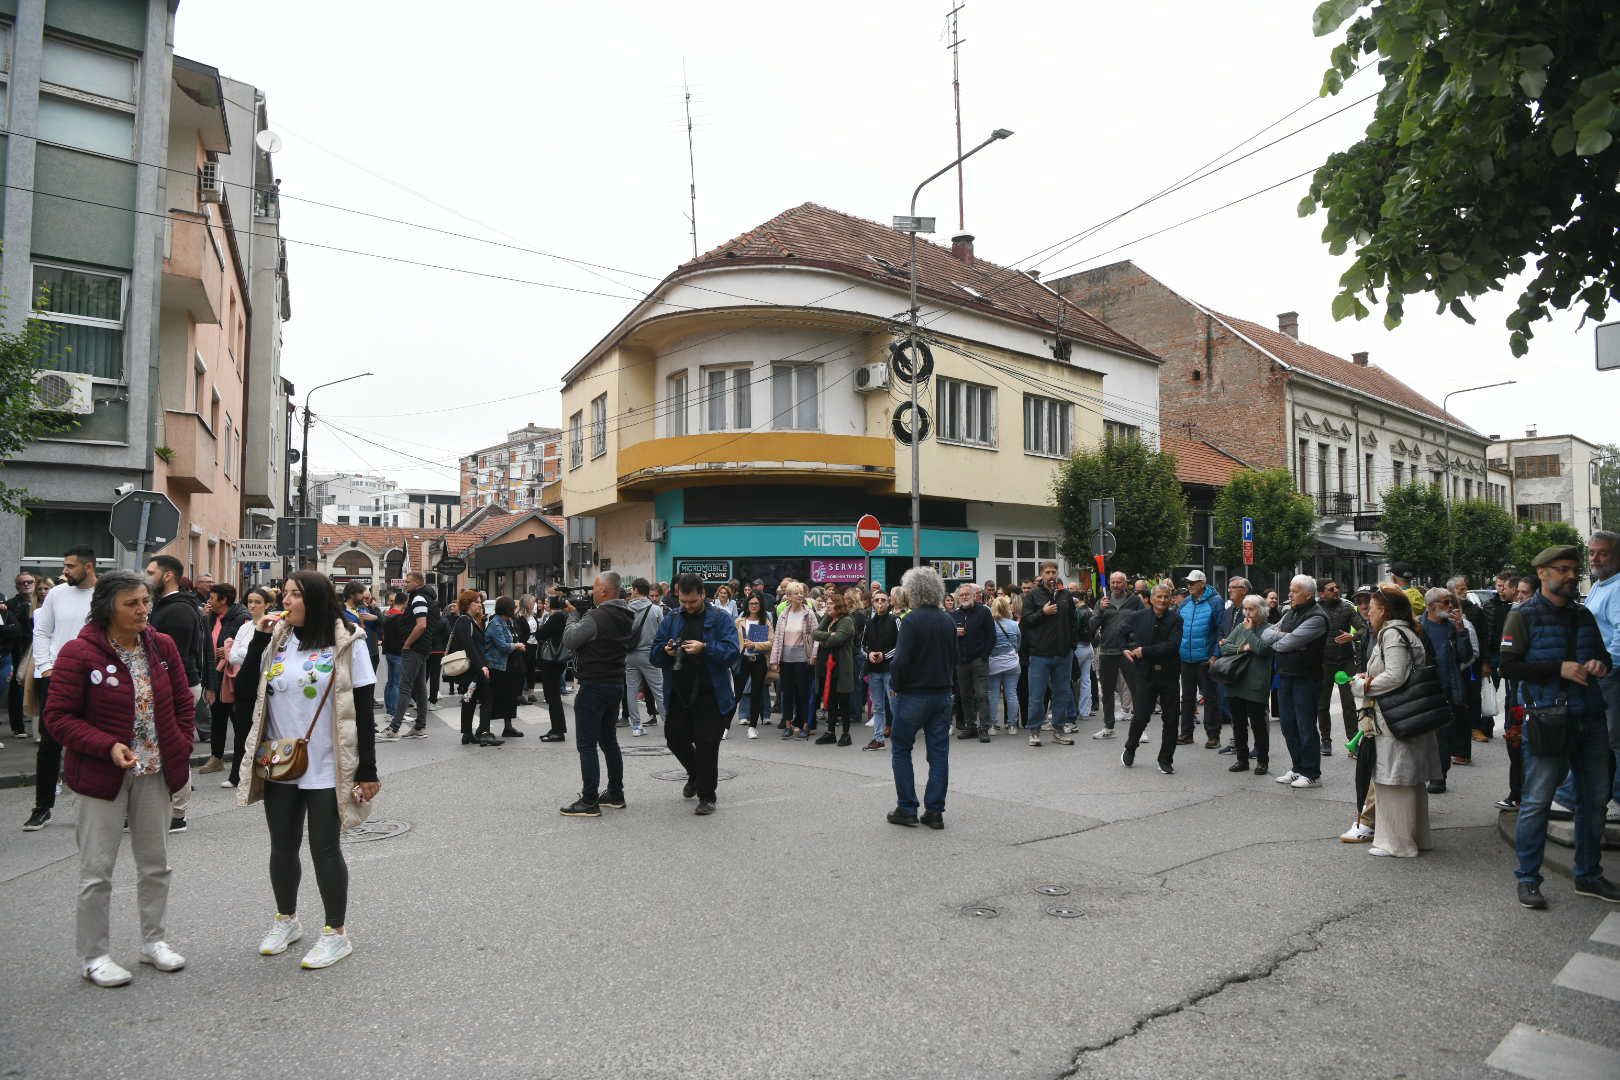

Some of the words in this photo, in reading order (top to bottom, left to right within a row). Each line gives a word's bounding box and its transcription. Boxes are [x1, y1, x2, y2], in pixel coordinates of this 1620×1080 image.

[1245, 520, 1251, 538] P
[803, 532, 899, 548] MICROILE
[681, 564, 728, 572] MICROMOBILE
[829, 563, 864, 571] SERVIS
